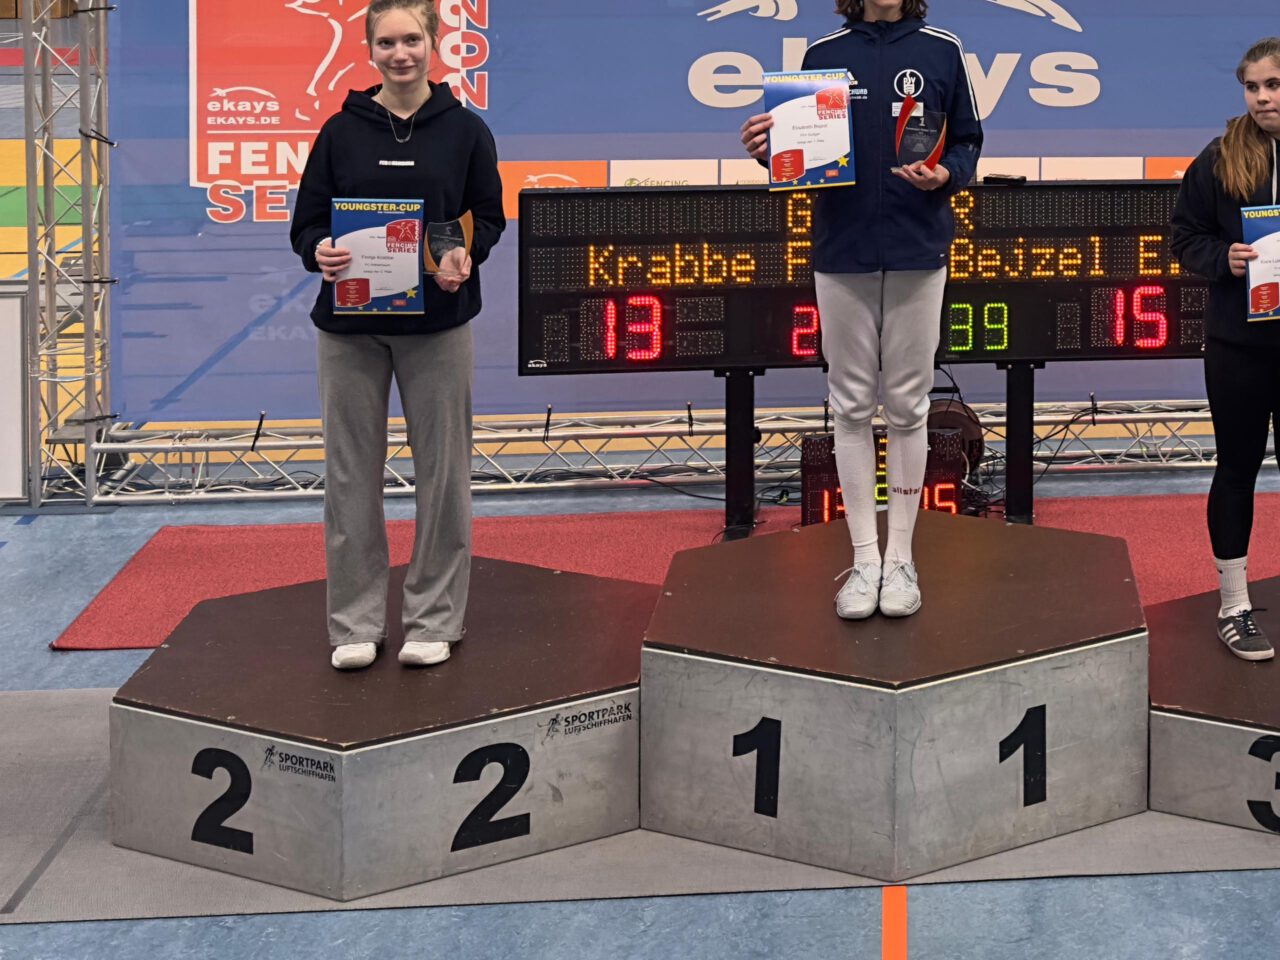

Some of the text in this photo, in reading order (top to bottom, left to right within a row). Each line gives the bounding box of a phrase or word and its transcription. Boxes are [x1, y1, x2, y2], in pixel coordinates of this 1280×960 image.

[764, 72, 846, 83] YOUNGSTER-CUP
[207, 98, 280, 114] ekays
[207, 115, 281, 125] EKAYS.DE
[334, 202, 421, 212] YOUNGSTER-CUP
[588, 242, 757, 286] Krabbe
[950, 236, 1181, 277] Bejzel E.
[604, 295, 662, 361] 13
[791, 305, 819, 356] 2
[950, 303, 1009, 351] 39
[1115, 285, 1168, 349] 15
[564, 702, 632, 728] SPORTPARK
[564, 713, 633, 736] LUFTSCHIFFHAFEN
[278, 752, 335, 774] SPORTPARK
[278, 764, 337, 783] LUFTSCHIFFHAFEN
[732, 715, 782, 819] 1
[998, 703, 1048, 808] 1
[190, 746, 254, 855] 2
[450, 740, 532, 853] 2
